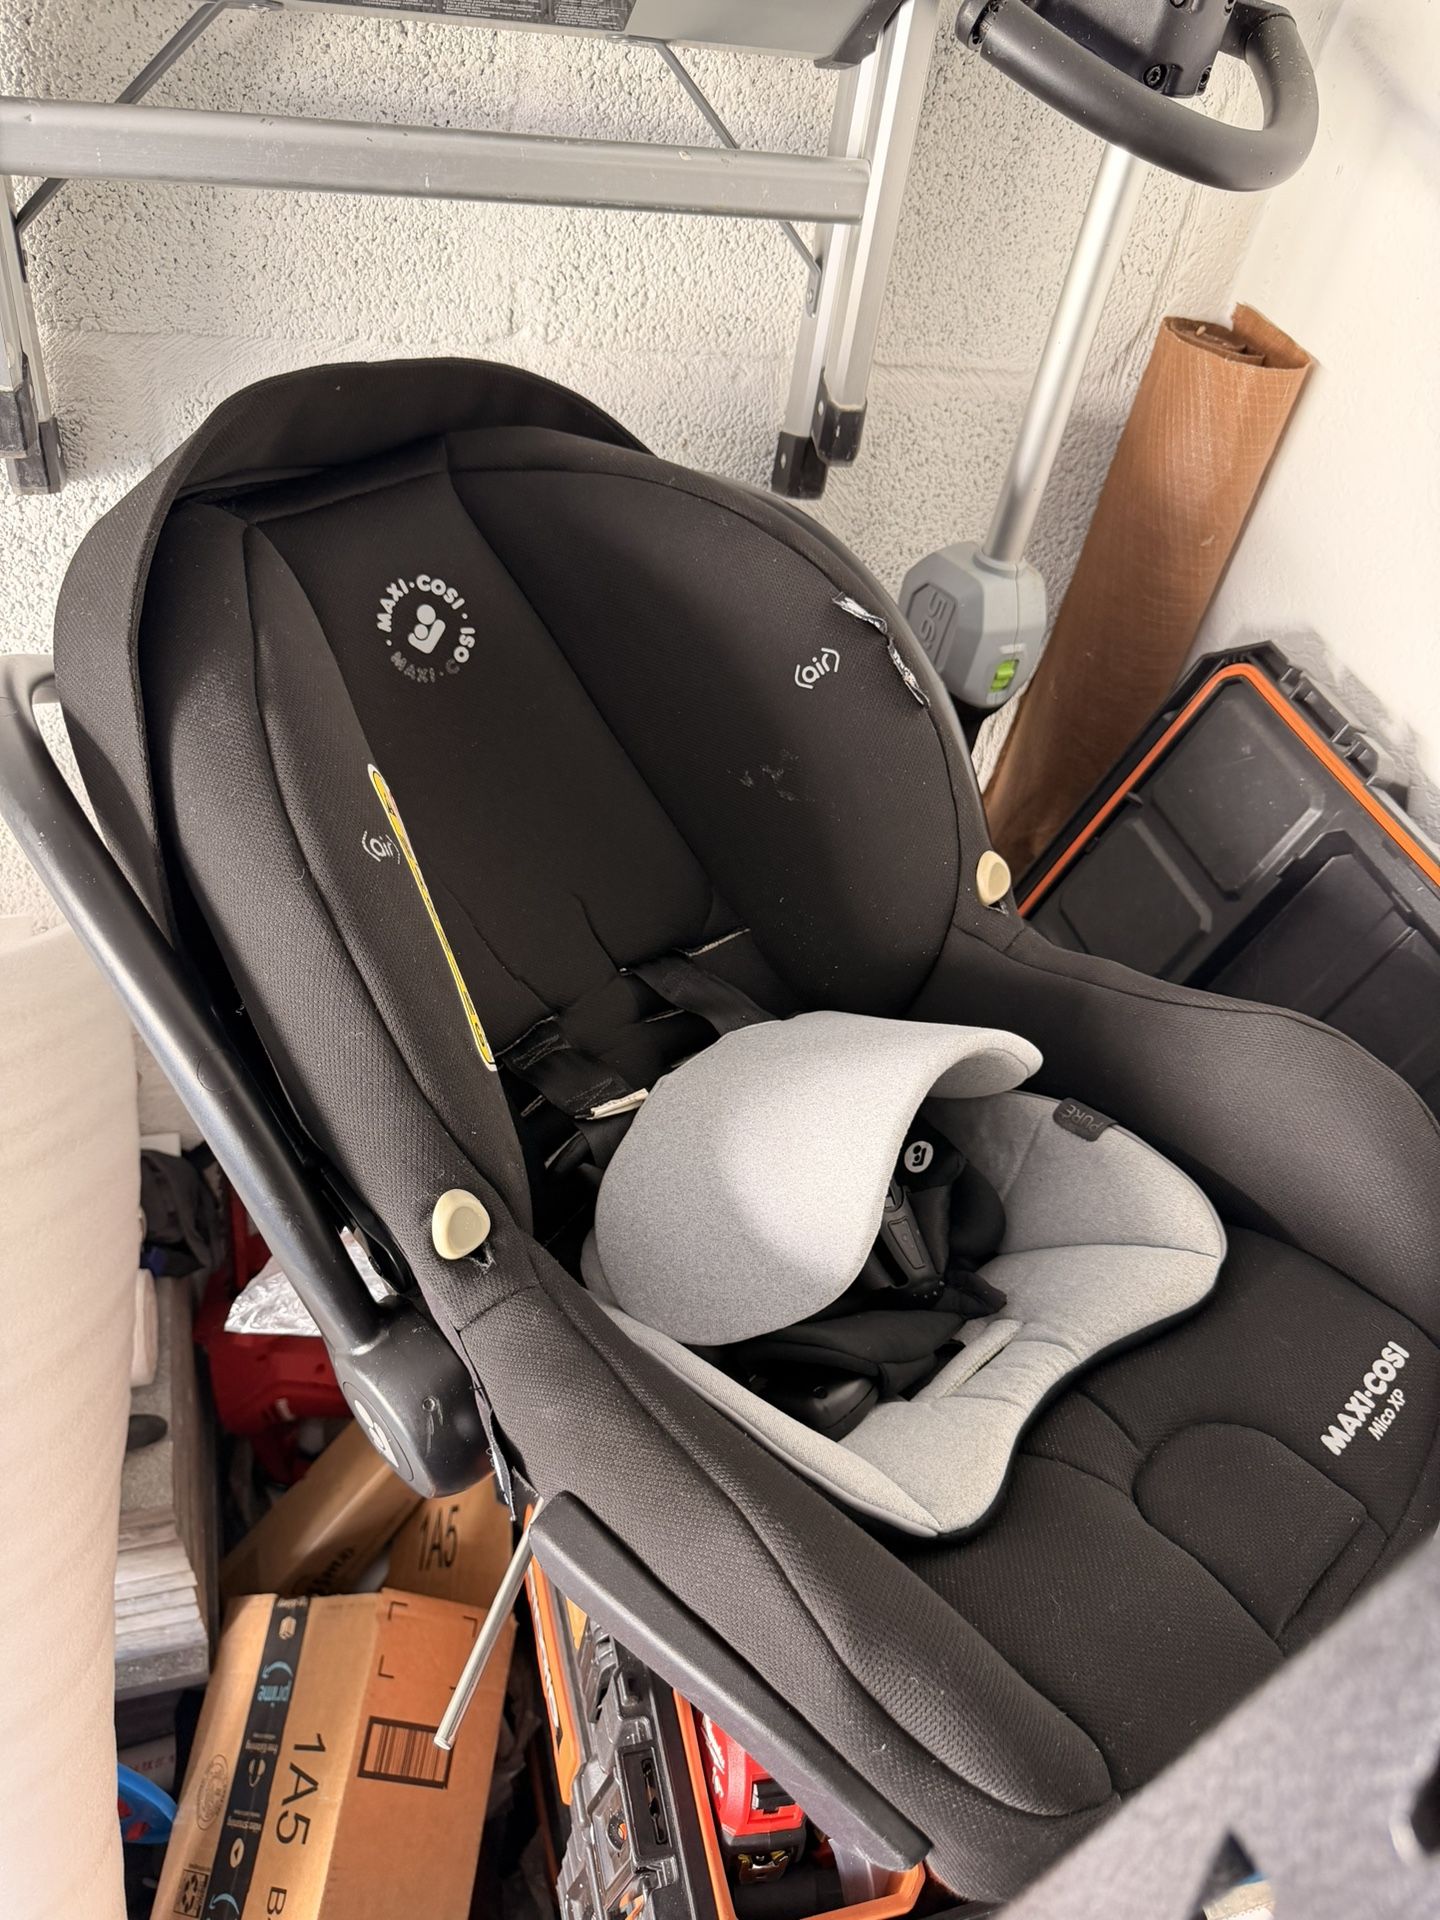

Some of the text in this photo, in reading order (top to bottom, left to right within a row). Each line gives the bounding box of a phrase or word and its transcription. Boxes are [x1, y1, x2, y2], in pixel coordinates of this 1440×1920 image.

[919, 590, 949, 652] 56
[1060, 1104, 1104, 1133] PURE
[1367, 1388, 1406, 1441] Mico XP
[418, 1504, 460, 1571] 1A5
[257, 1680, 292, 1708] prime
[266, 1733, 326, 1920] 1A5 B
